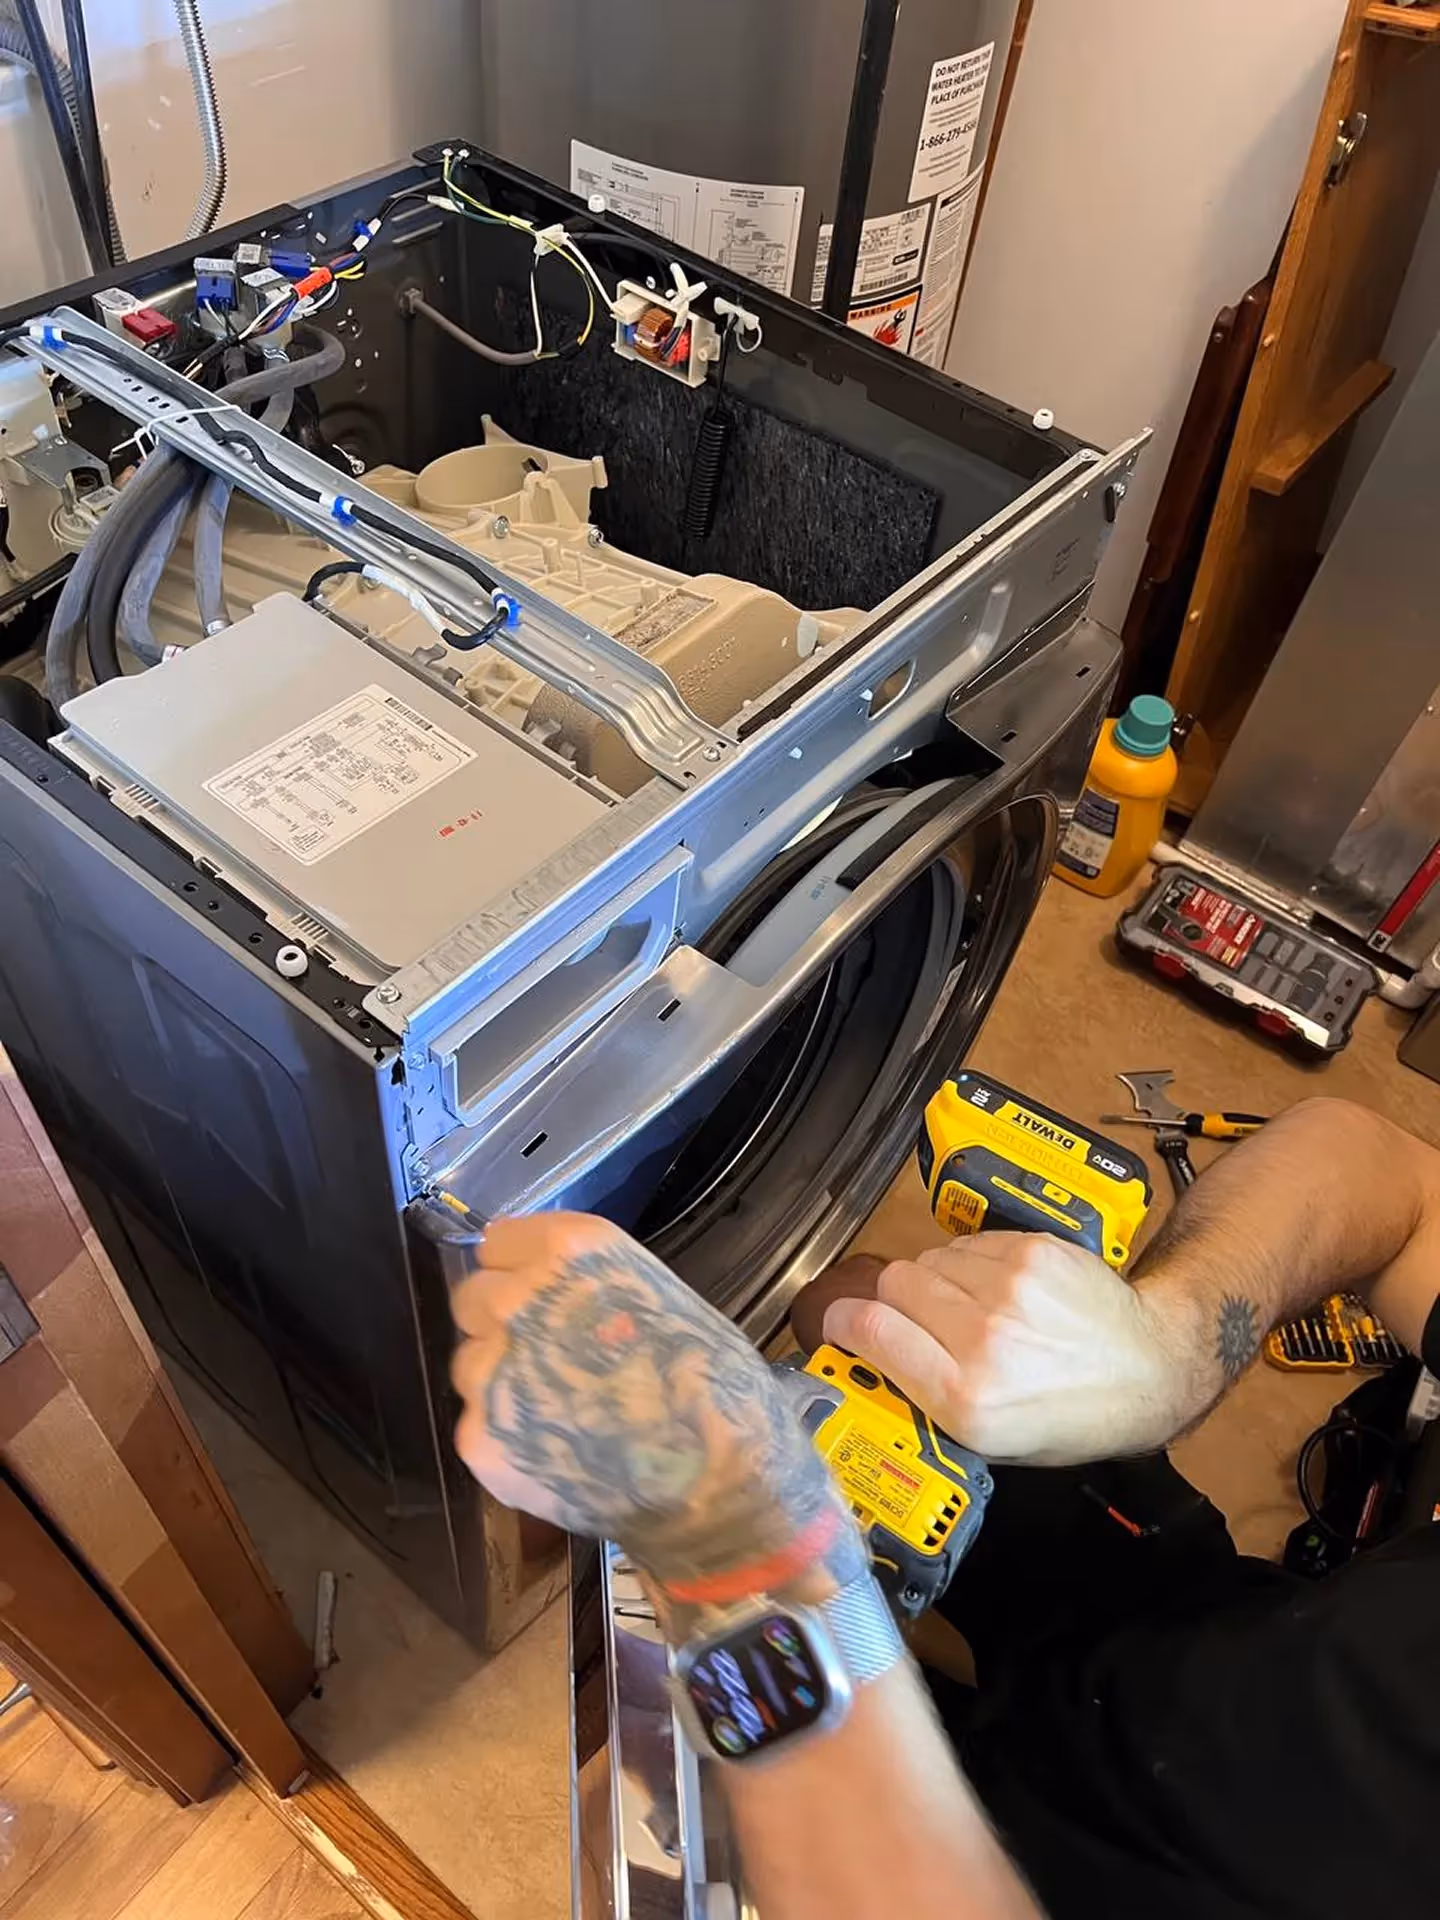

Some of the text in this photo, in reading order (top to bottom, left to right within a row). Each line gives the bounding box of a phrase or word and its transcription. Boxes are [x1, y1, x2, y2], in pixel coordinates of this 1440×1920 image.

[936, 67, 946, 77] DO
[948, 62, 960, 73] NOT
[931, 78, 953, 92] WATER
[931, 91, 951, 105] PLACE
[951, 88, 961, 99] OF
[850, 304, 892, 320] WARNING
